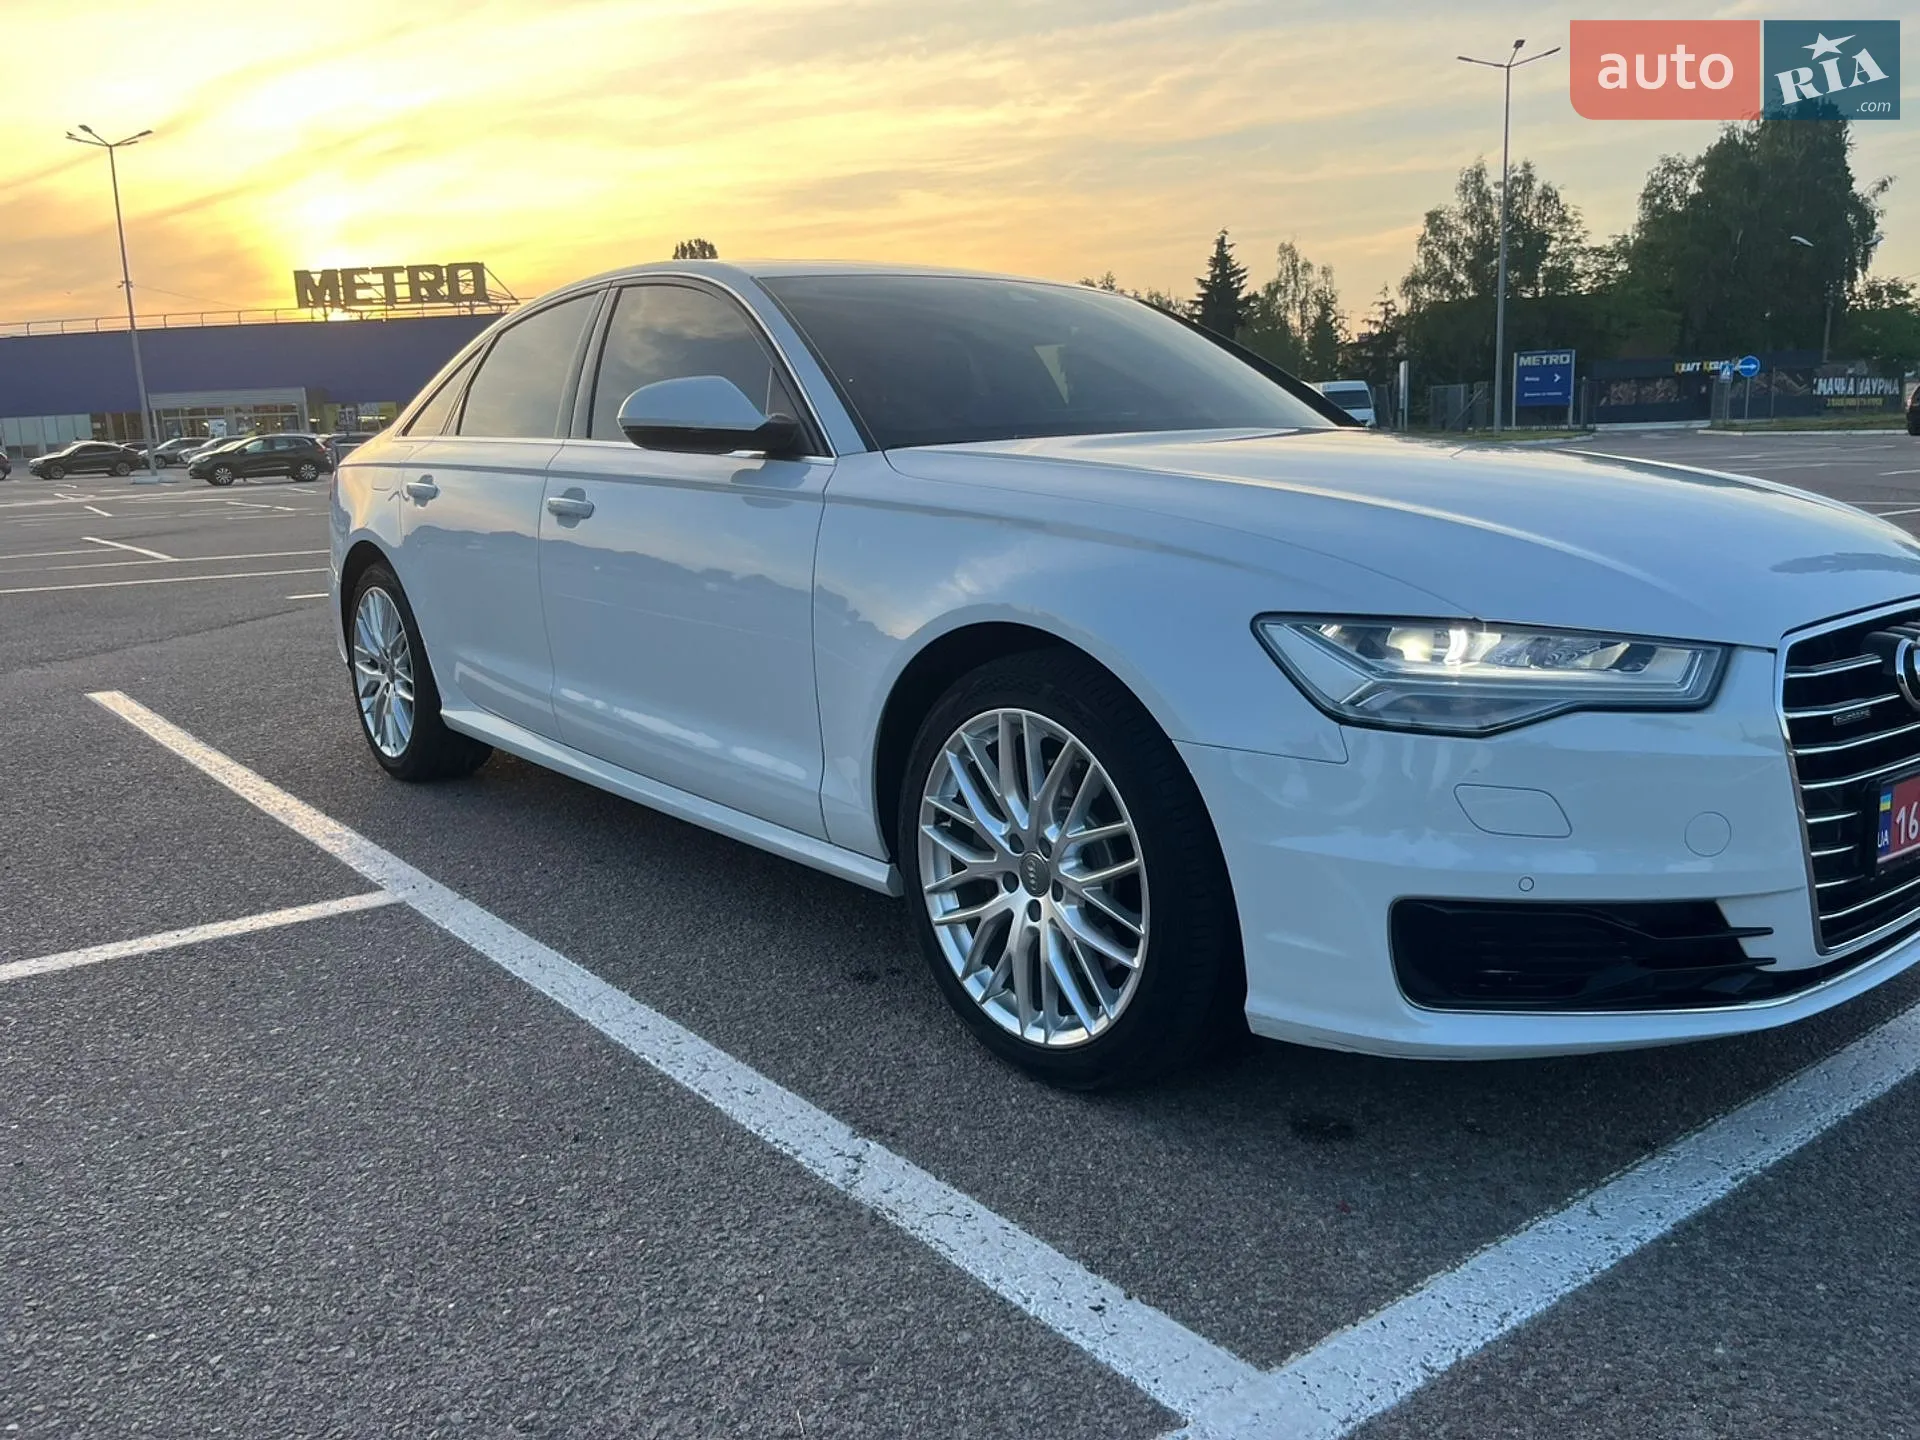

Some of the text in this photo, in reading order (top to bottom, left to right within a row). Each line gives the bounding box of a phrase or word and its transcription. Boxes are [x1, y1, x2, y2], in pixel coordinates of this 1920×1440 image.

[293, 262, 488, 309] METRO
[1519, 354, 1571, 367] METRO
[1877, 829, 1890, 848] UA
[1896, 801, 1919, 845] 16
